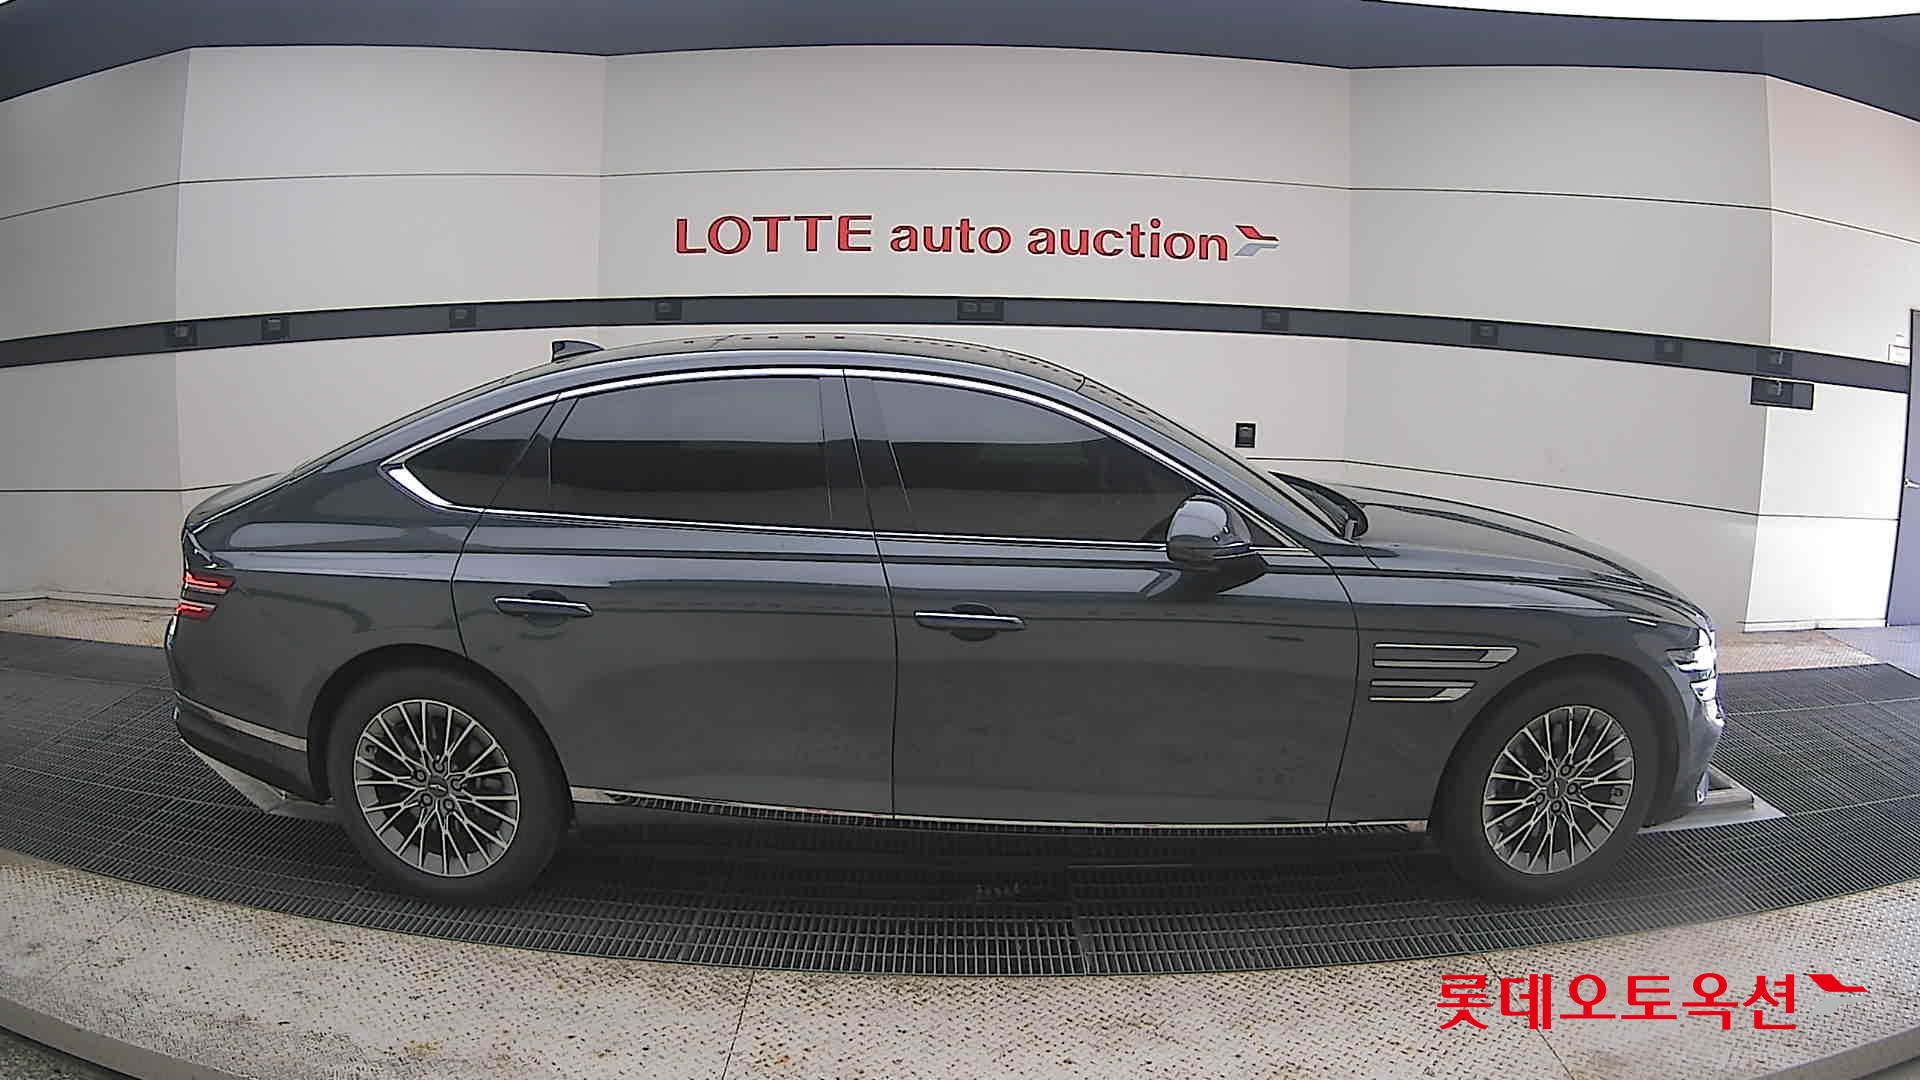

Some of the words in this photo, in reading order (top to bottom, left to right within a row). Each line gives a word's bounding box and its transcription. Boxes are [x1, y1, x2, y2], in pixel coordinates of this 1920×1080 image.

[676, 215, 873, 254] LOTTE
[890, 219, 1012, 254] auto
[1027, 219, 1229, 261] auction
